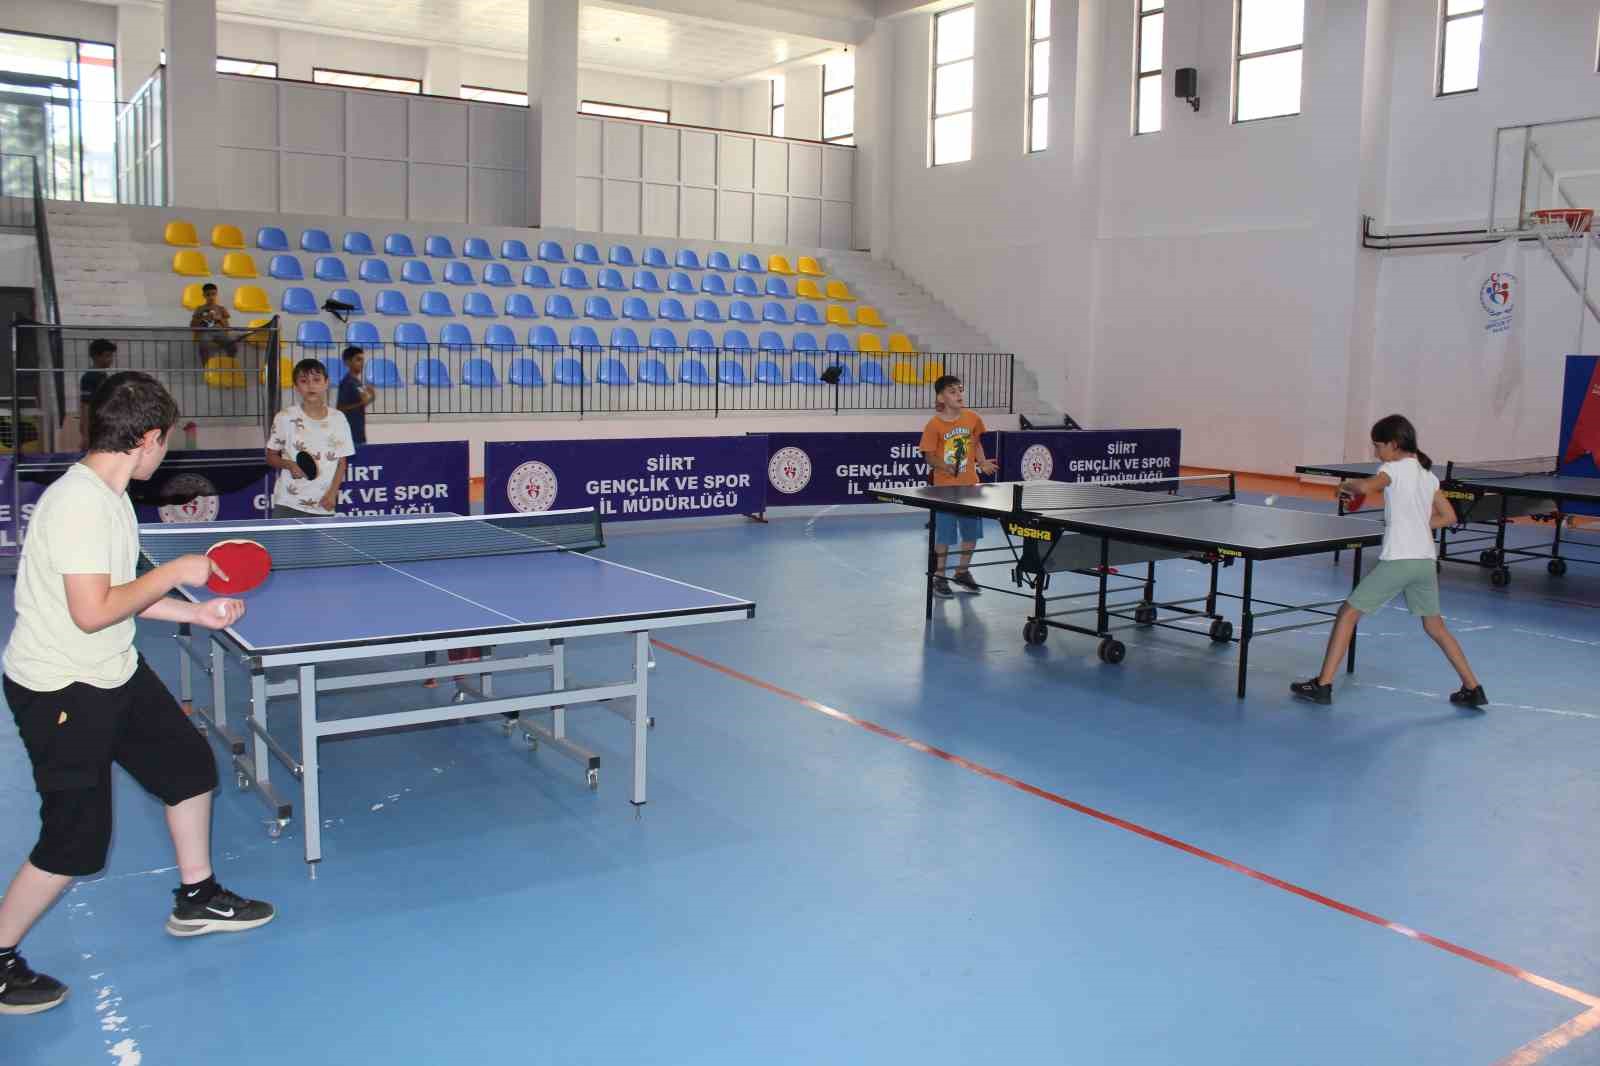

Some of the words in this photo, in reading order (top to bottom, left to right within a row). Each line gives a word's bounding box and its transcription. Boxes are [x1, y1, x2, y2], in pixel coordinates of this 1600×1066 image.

[890, 444, 923, 459] SİİR
[1107, 441, 1138, 455] SİİRT
[646, 454, 696, 471] SİİRT
[836, 461, 911, 479] GENÇLİK
[1069, 457, 1121, 473] GENÇLİK
[1124, 459, 1139, 469] VE
[1142, 457, 1170, 469] SPOR
[360, 488, 388, 503] VE
[395, 483, 449, 501] SPOR
[586, 475, 670, 496] GENÇLİK
[674, 476, 698, 490] VE
[703, 474, 751, 489] SPOR
[848, 480, 863, 495] İL
[600, 497, 617, 515] İL
[623, 491, 738, 514] MÜDÜRLÜĞÜ
[1008, 523, 1052, 540] Yasaka
